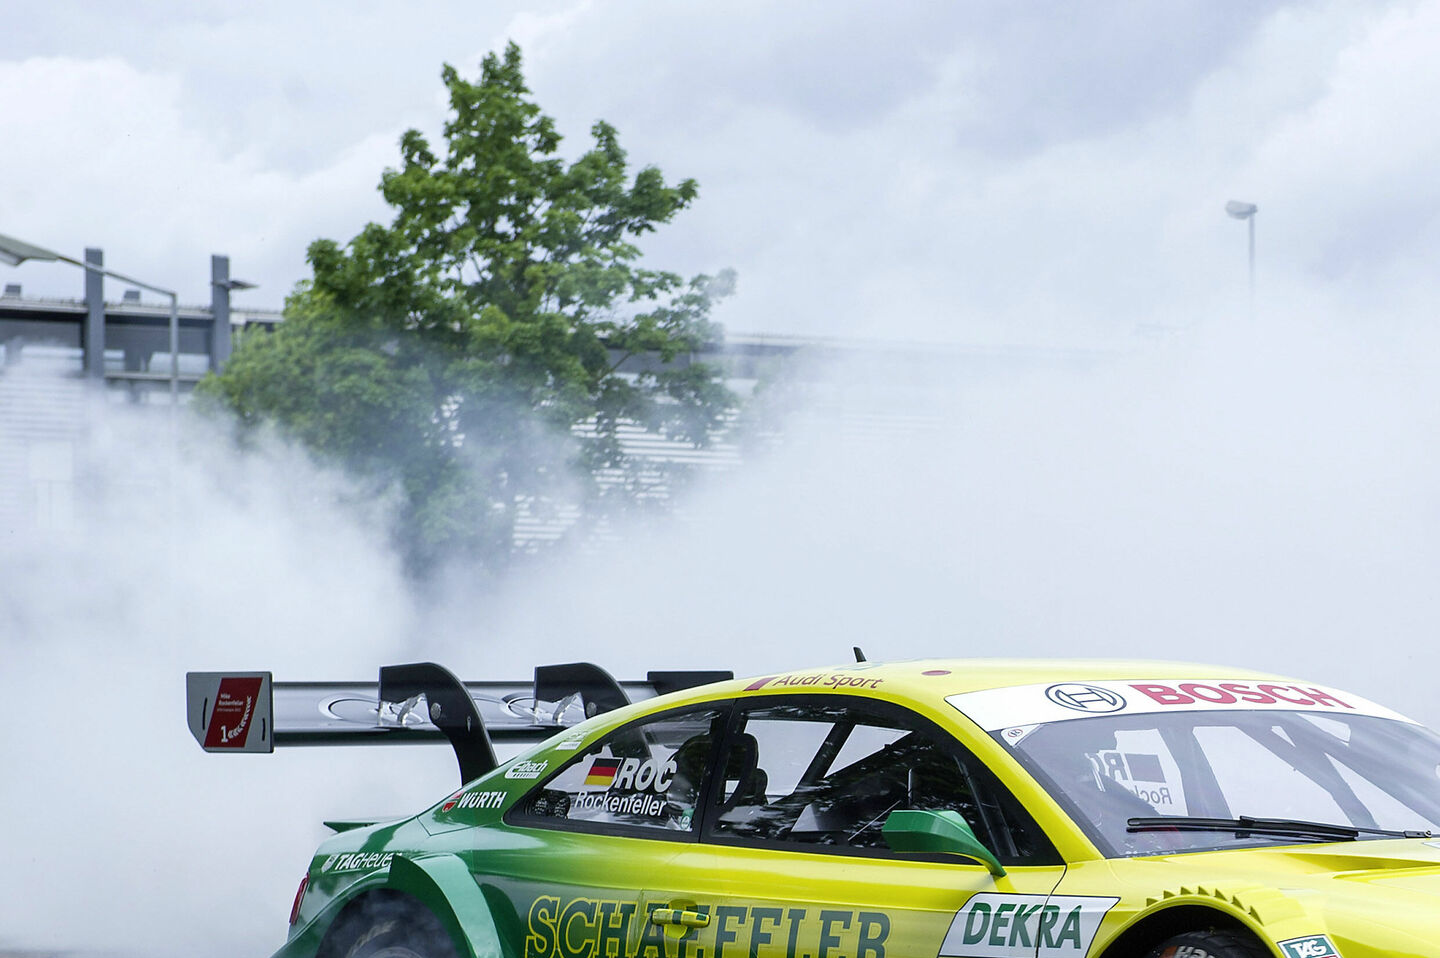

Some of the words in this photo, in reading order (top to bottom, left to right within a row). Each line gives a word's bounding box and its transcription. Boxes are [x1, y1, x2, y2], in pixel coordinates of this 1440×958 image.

[772, 674, 825, 687] Audi
[823, 674, 884, 690] Sport
[1128, 683, 1356, 709] BOSCH
[615, 757, 678, 793] ROC
[574, 791, 667, 817] Rockenfeller
[963, 902, 1083, 950] DEKRA
[1290, 940, 1327, 958] TAG
